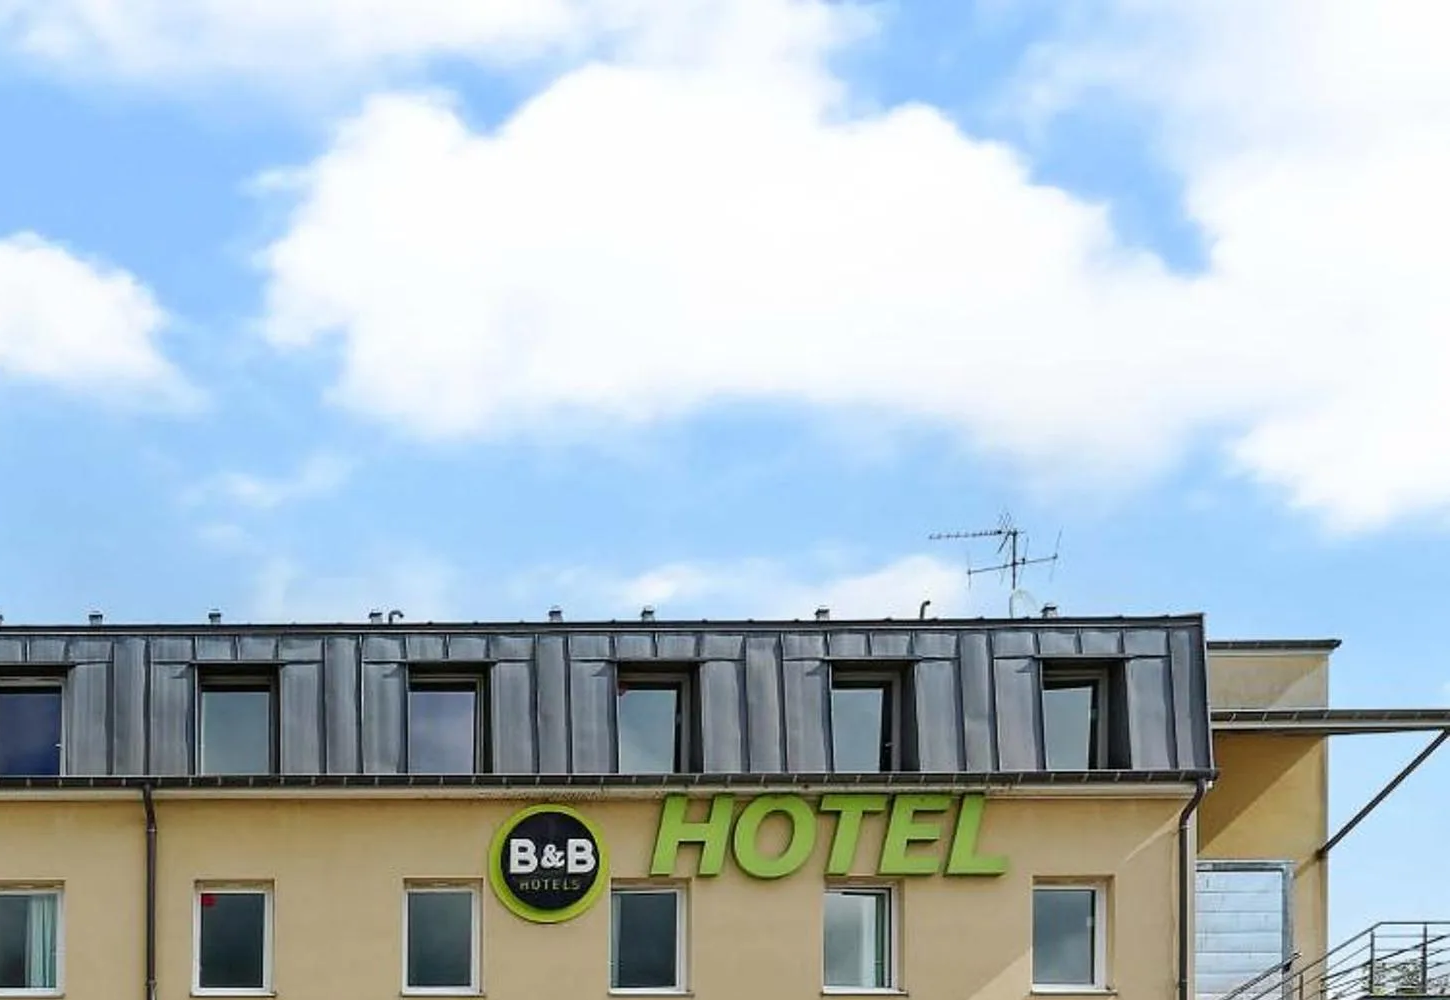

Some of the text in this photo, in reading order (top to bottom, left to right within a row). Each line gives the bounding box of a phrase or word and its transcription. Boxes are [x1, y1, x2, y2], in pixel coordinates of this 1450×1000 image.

[649, 791, 1009, 880] HOTEL
[510, 838, 596, 873] B&B
[519, 879, 581, 891] HOTELS
